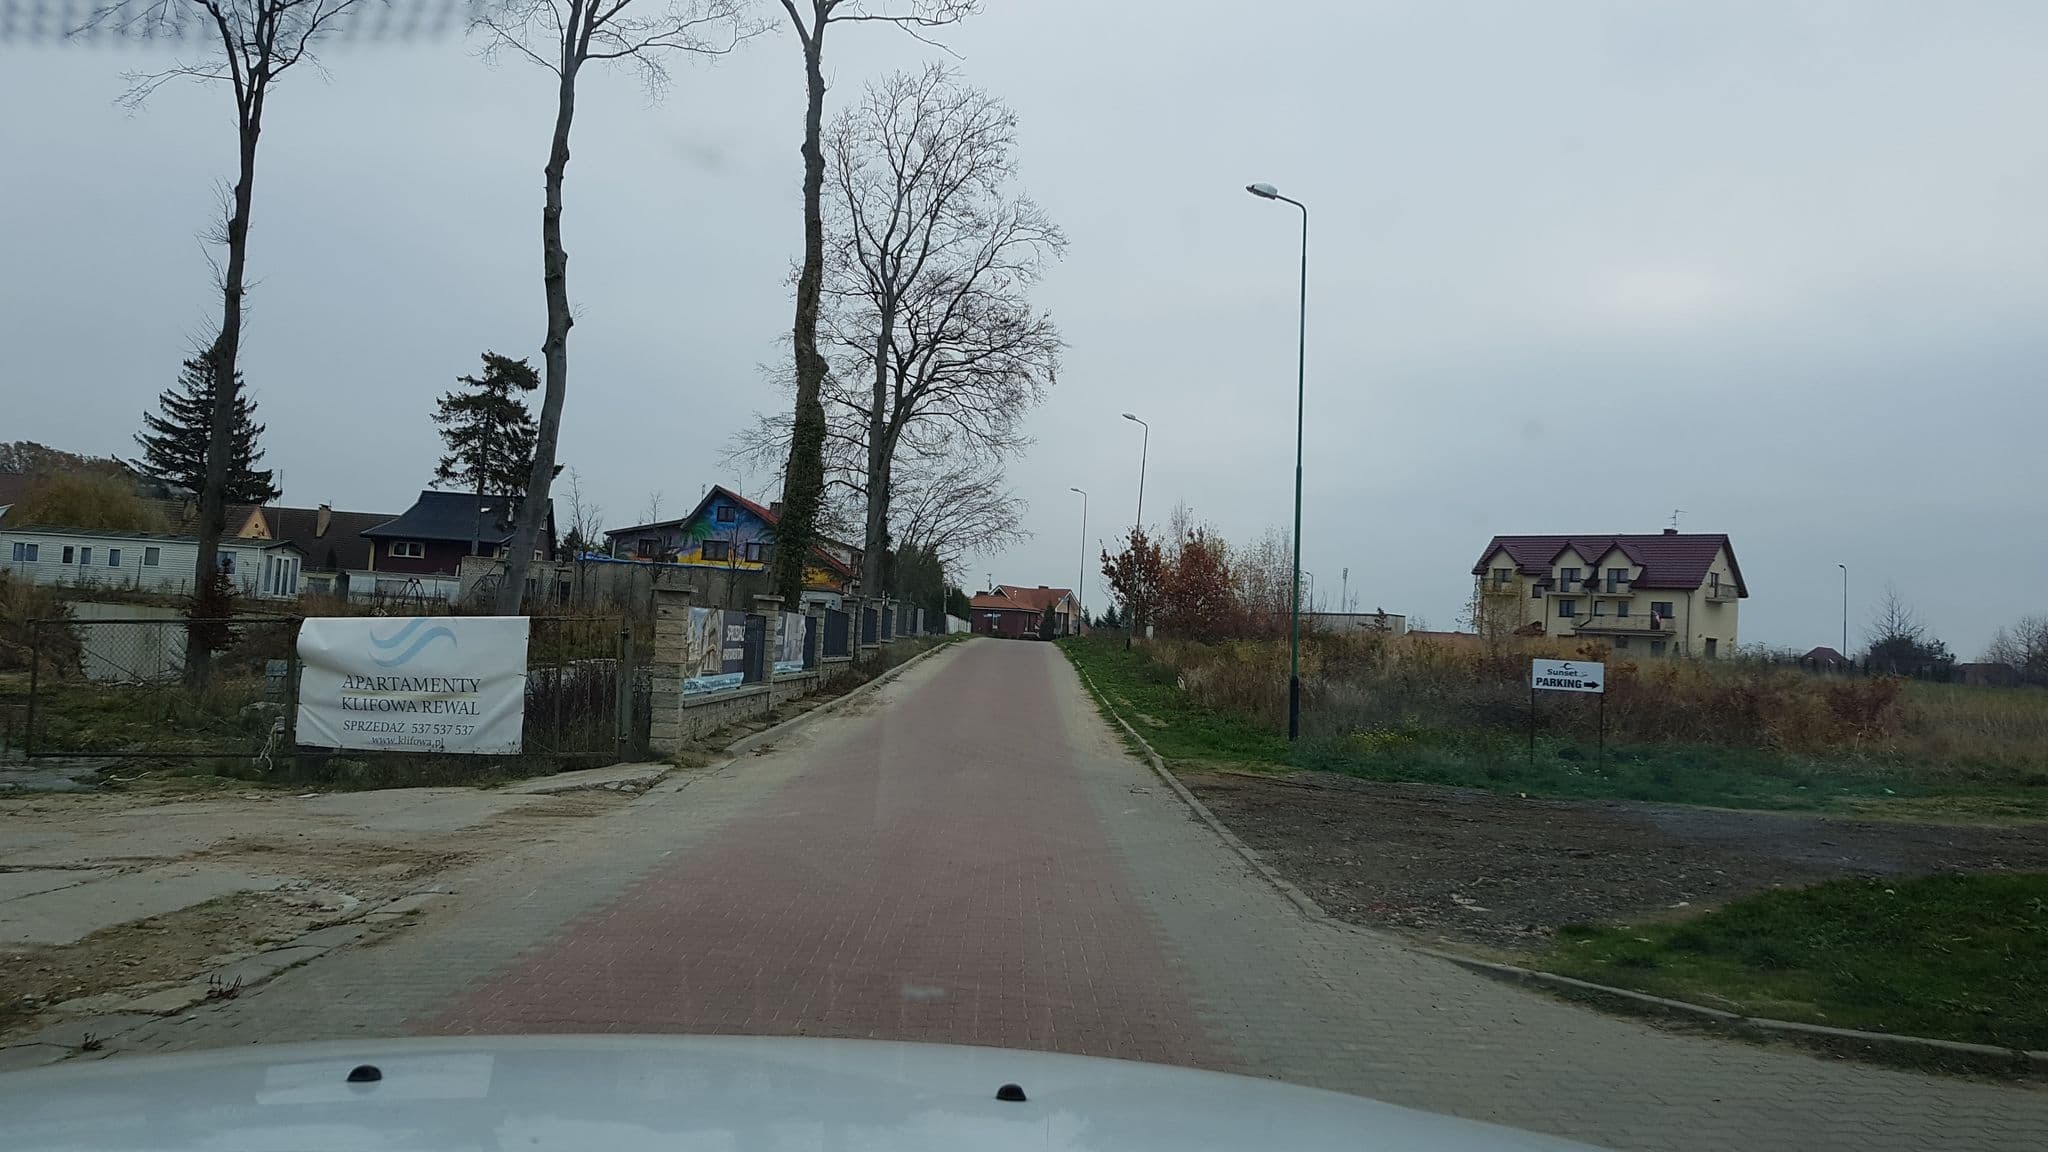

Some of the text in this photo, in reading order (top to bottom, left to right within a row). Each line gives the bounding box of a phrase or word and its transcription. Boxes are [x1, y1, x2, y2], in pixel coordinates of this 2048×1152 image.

[1547, 668, 1578, 677] Sunset
[342, 674, 480, 693] APARTAMENTY
[1535, 677, 1582, 688] PARKING
[341, 697, 480, 715] KLIFOWA REWAL
[343, 720, 475, 736] SPRZEDAŻ 537 537 537
[370, 736, 444, 749] www.klifowa.pl
